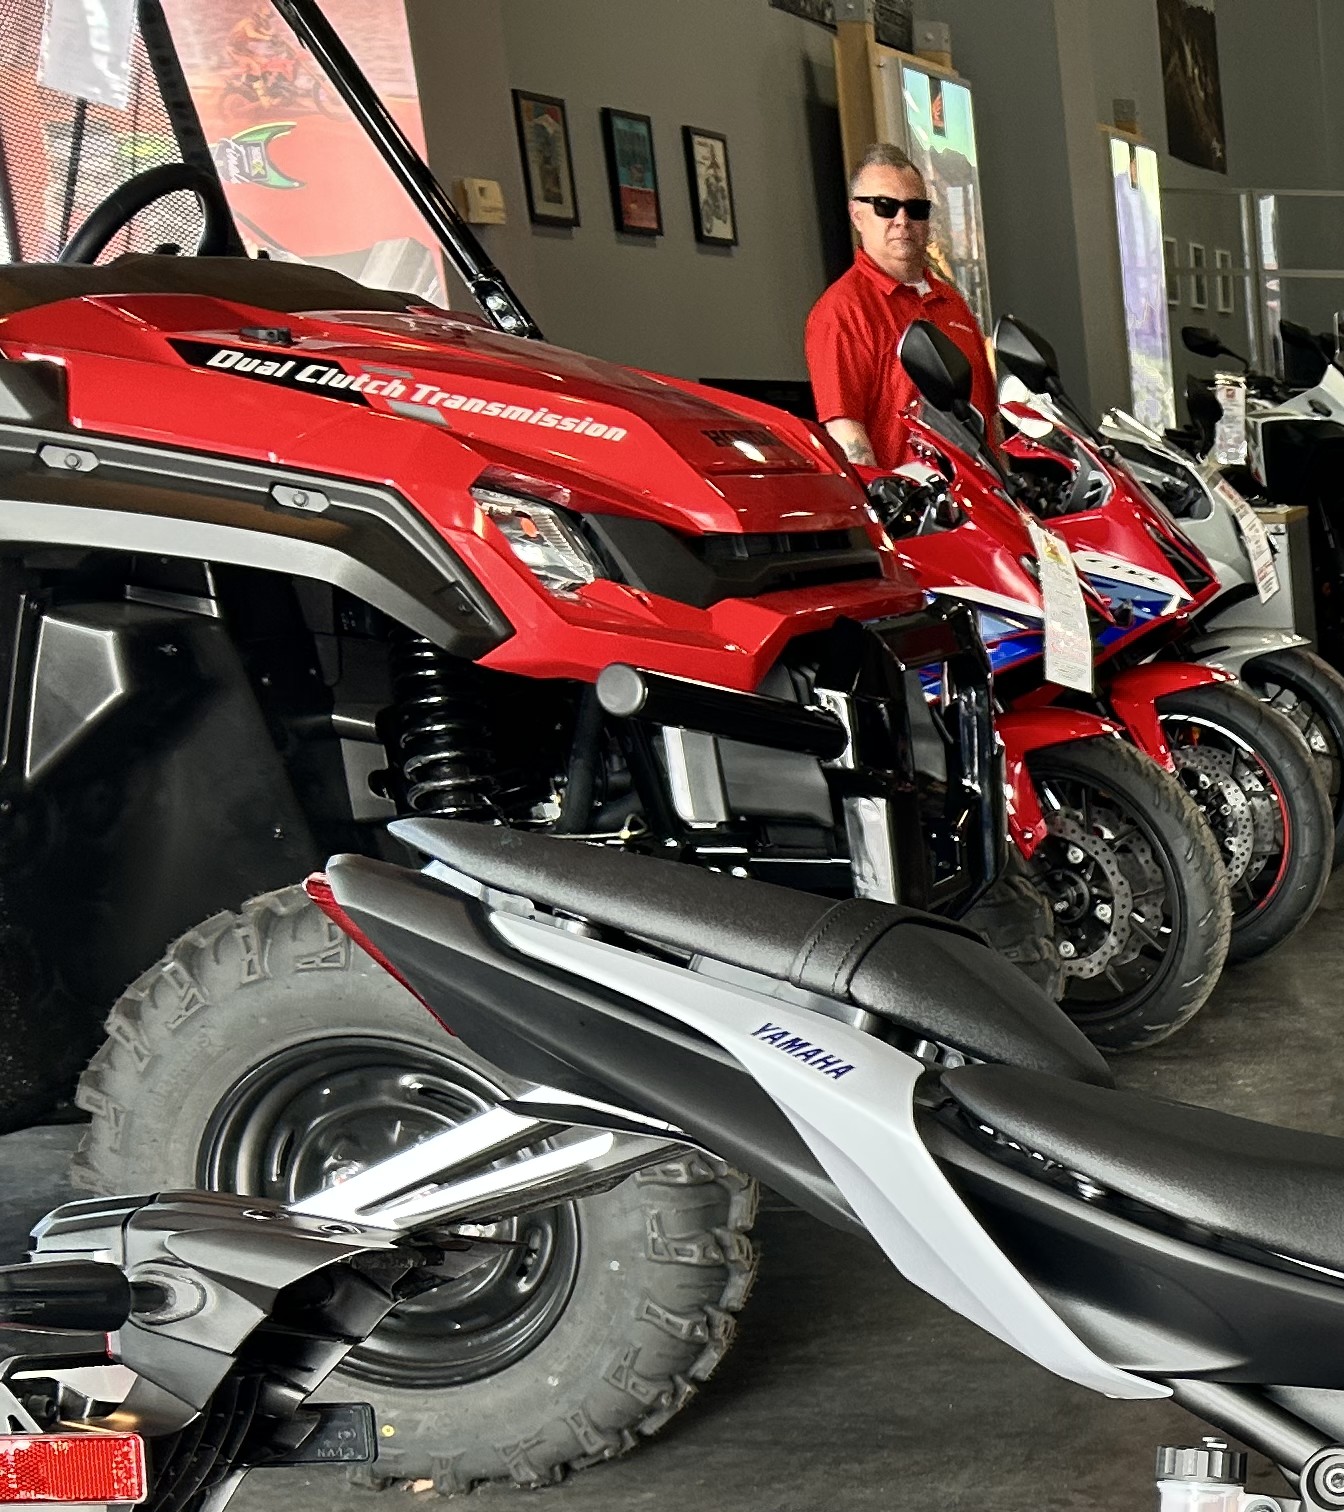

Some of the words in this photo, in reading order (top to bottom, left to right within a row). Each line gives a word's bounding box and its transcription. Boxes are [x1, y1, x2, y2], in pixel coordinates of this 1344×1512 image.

[205, 348, 297, 379] Dual
[295, 365, 405, 399] Clutch
[407, 383, 629, 442] Transmission
[751, 1022, 856, 1080] YAMAHA
